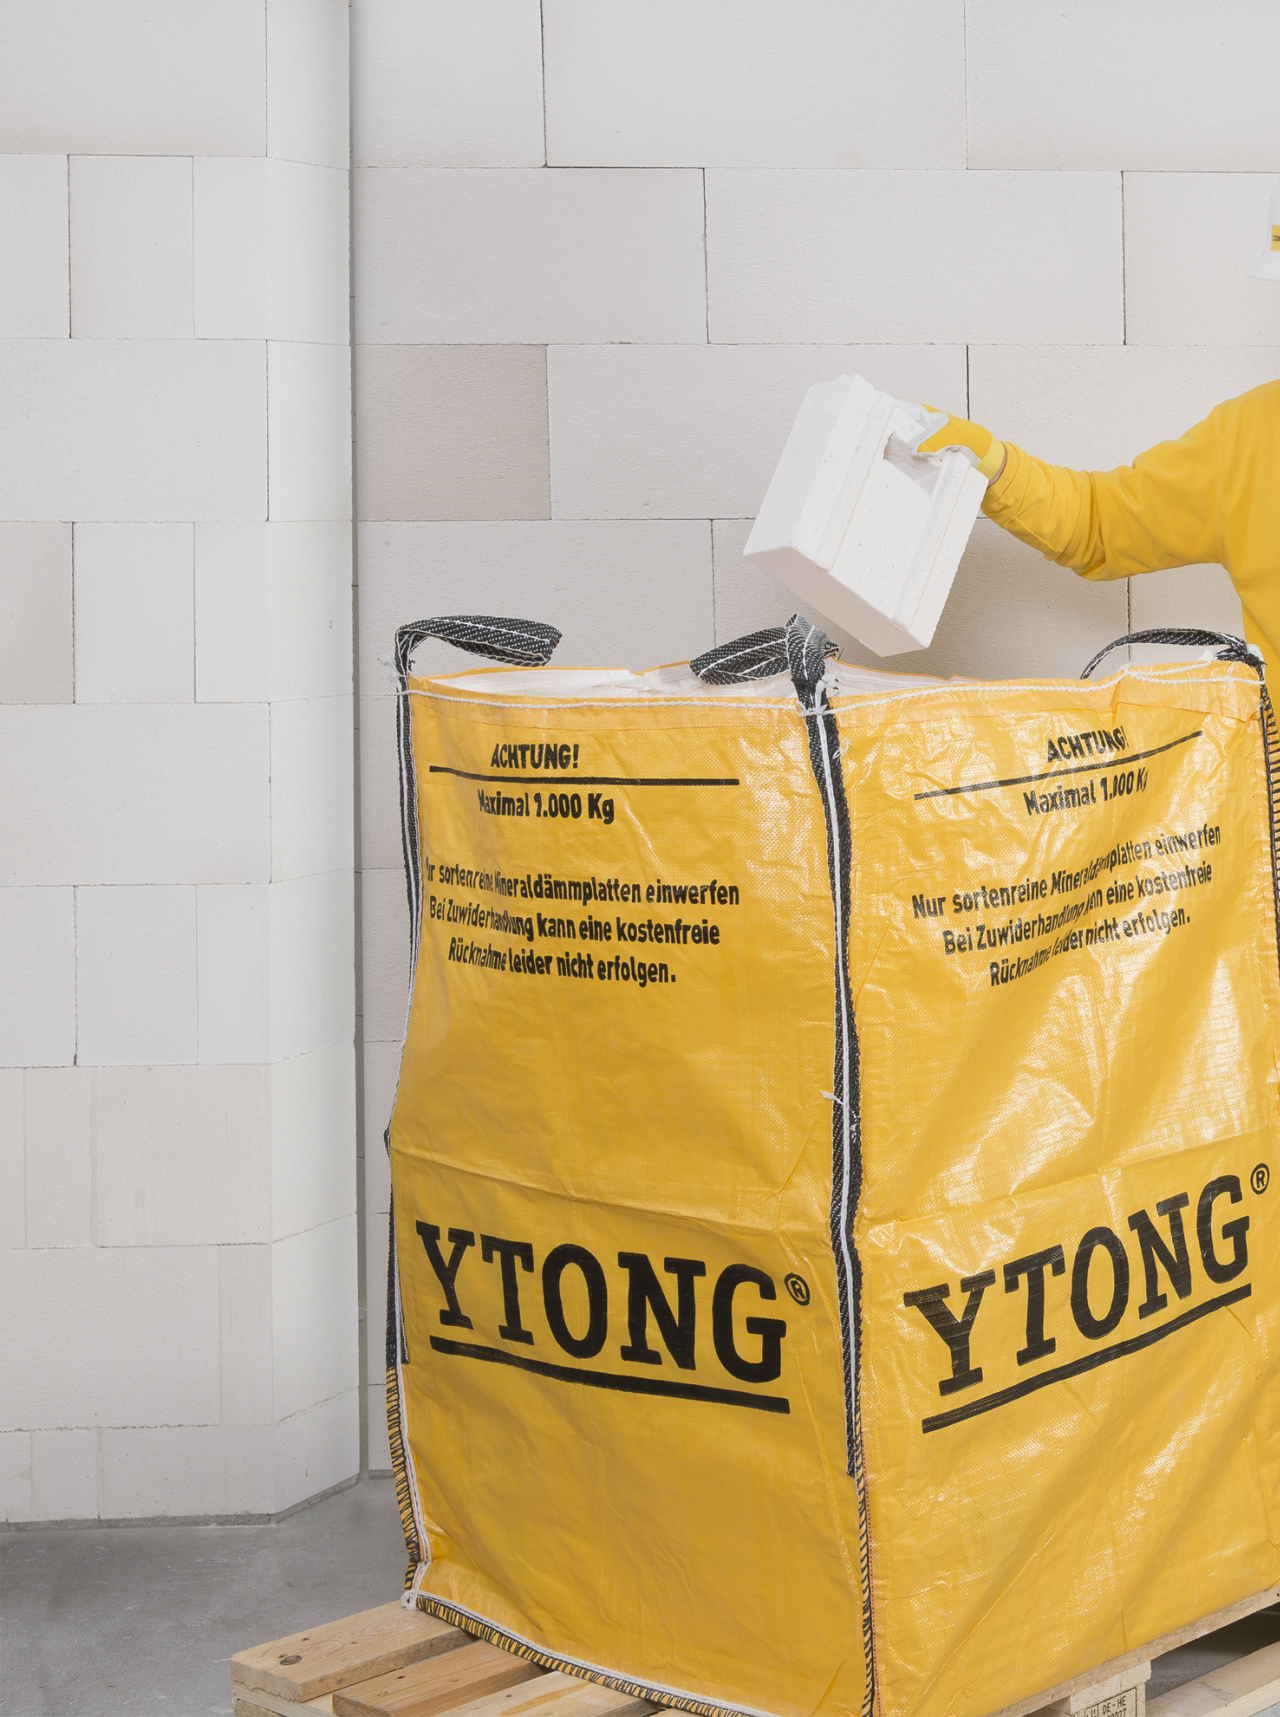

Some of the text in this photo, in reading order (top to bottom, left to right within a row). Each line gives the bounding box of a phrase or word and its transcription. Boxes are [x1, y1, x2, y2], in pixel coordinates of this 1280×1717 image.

[491, 744, 579, 769] ACHTUNG!
[1047, 726, 1129, 763] ACHTUNG!
[478, 789, 614, 824] Maximal 1.000 Kg
[1023, 779, 1097, 815] Maximal
[439, 864, 493, 892] sortenreine
[495, 870, 641, 906] Mineraldämmplatten
[646, 879, 740, 906] einwerfen
[912, 894, 946, 919] Nur
[953, 877, 1047, 914] sortenreine
[1154, 824, 1221, 858] einwerfen
[430, 896, 720, 945] Bei Zuwiderhandlung kann eine kostenfreie
[942, 927, 973, 955] Bei
[976, 901, 1085, 952] Zuwiderhandlung
[1106, 880, 1134, 905] eine
[1136, 861, 1212, 898] kostenfreie
[448, 937, 676, 988] Rücknahme leider nicht erfolgen.
[989, 945, 1052, 987] Rücknahme
[1086, 917, 1121, 946] nicht
[1122, 907, 1190, 937] erfolgen.
